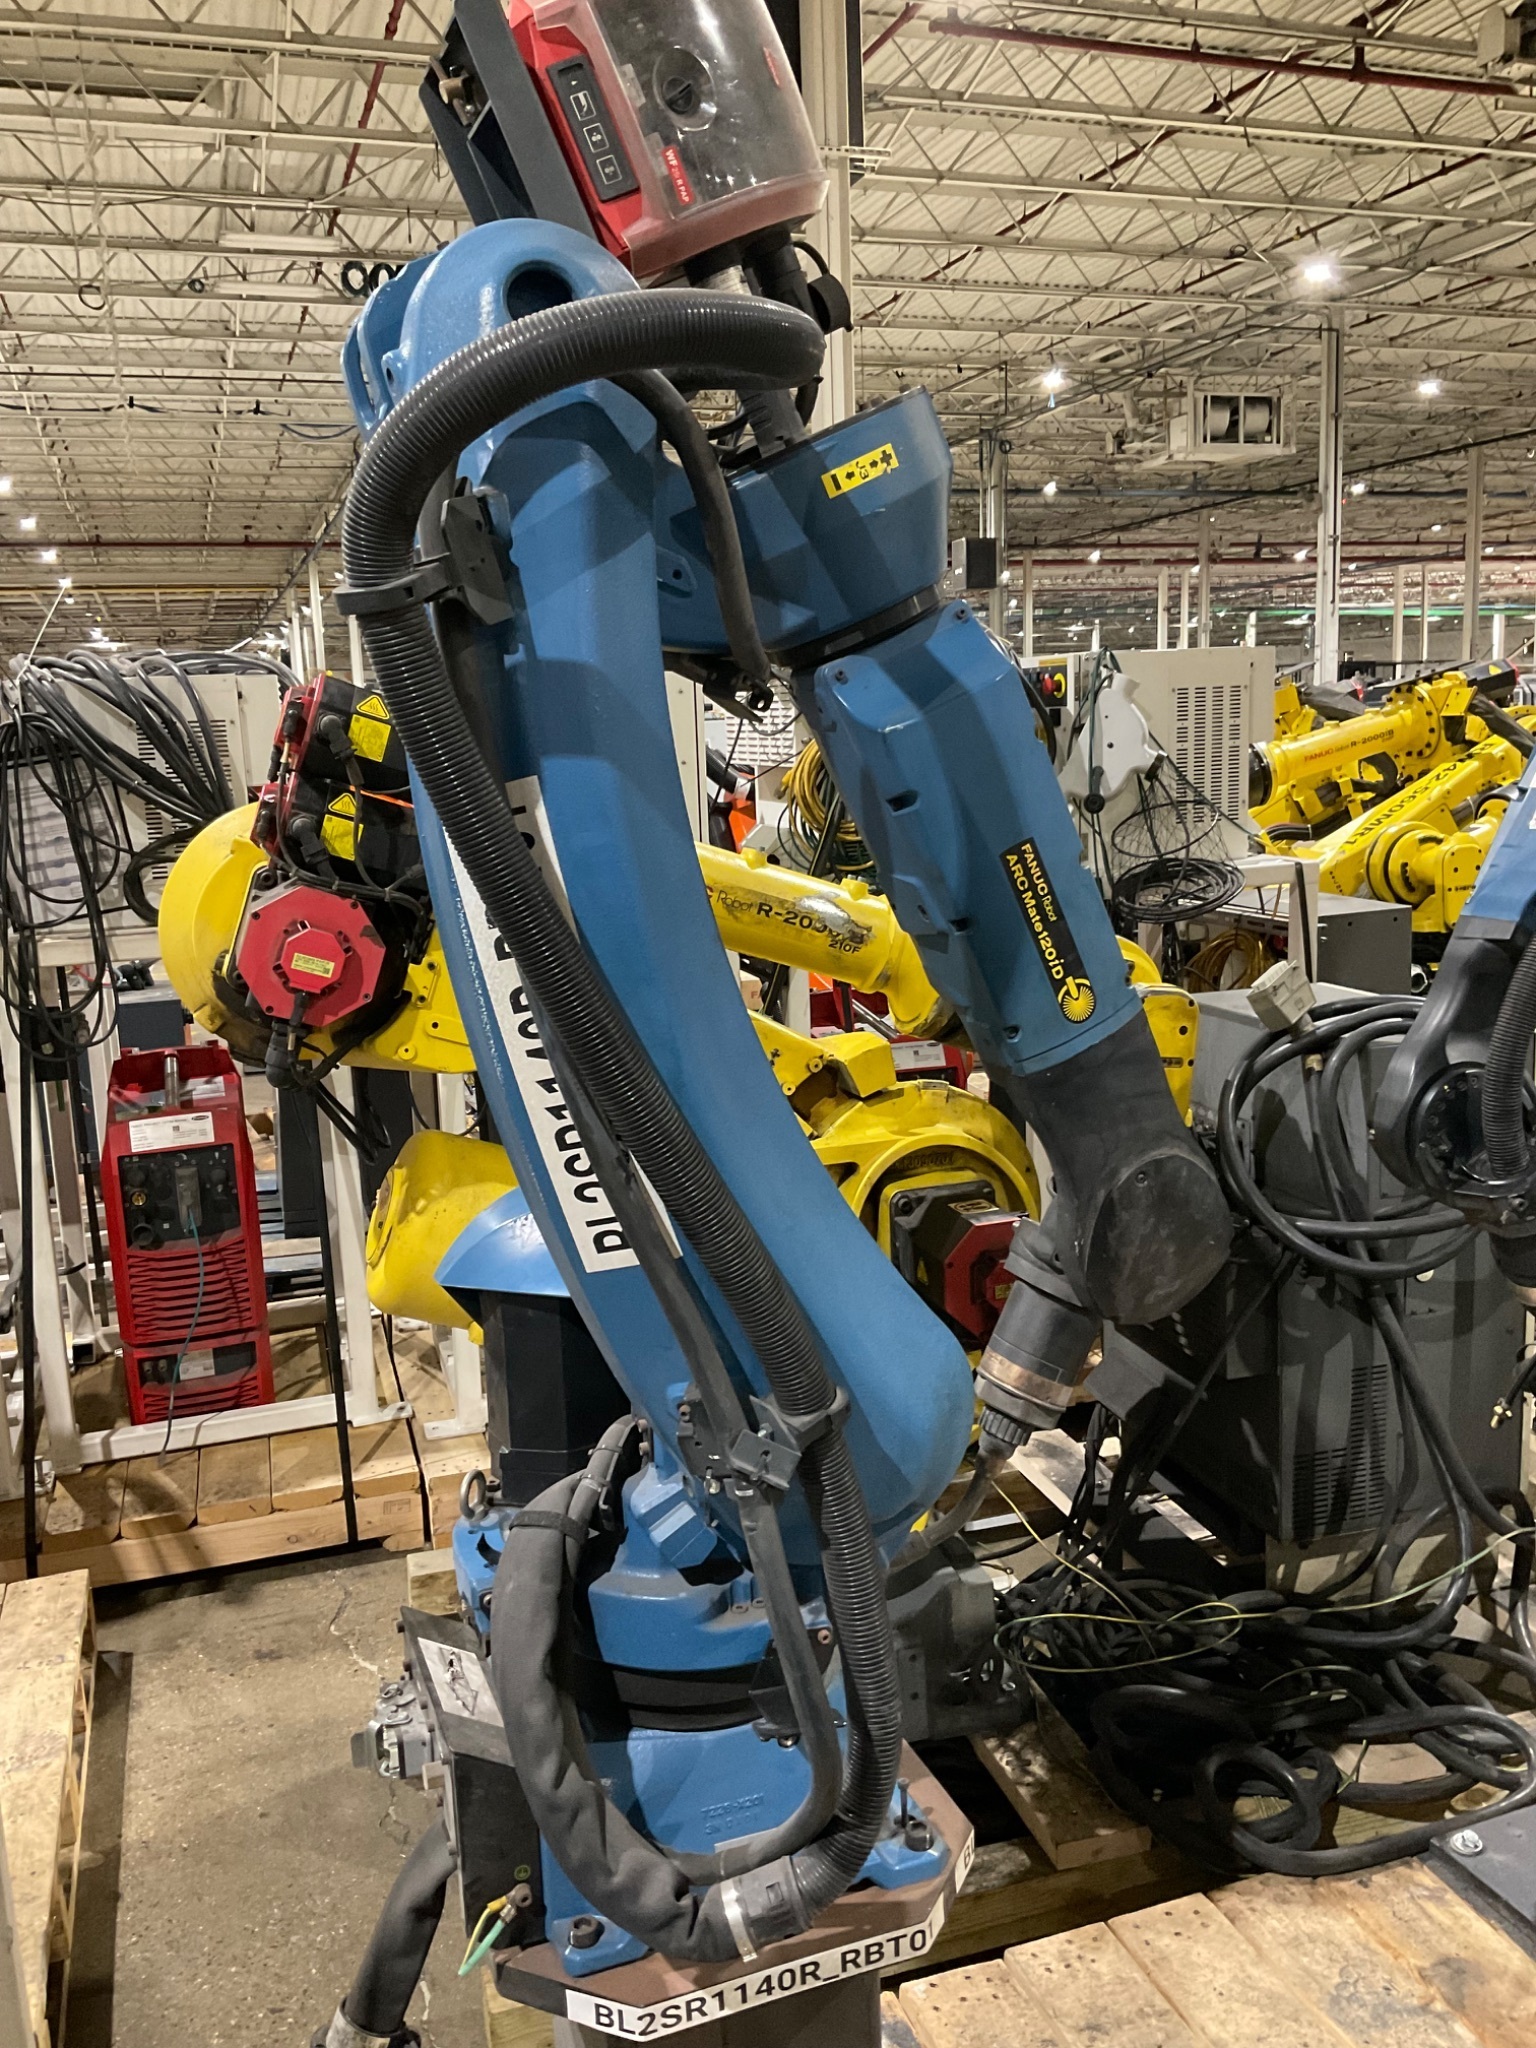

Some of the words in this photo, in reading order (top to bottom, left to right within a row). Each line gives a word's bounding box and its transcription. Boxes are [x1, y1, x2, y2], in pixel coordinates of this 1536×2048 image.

[665, 148, 678, 166] WF
[855, 460, 870, 481] J3
[1304, 748, 1333, 762] FANUC
[1006, 854, 1029, 891] ARC
[1021, 843, 1048, 896] FANUC
[1042, 894, 1058, 922] Robot
[717, 890, 753, 912] Robot
[828, 938, 862, 954] 210F
